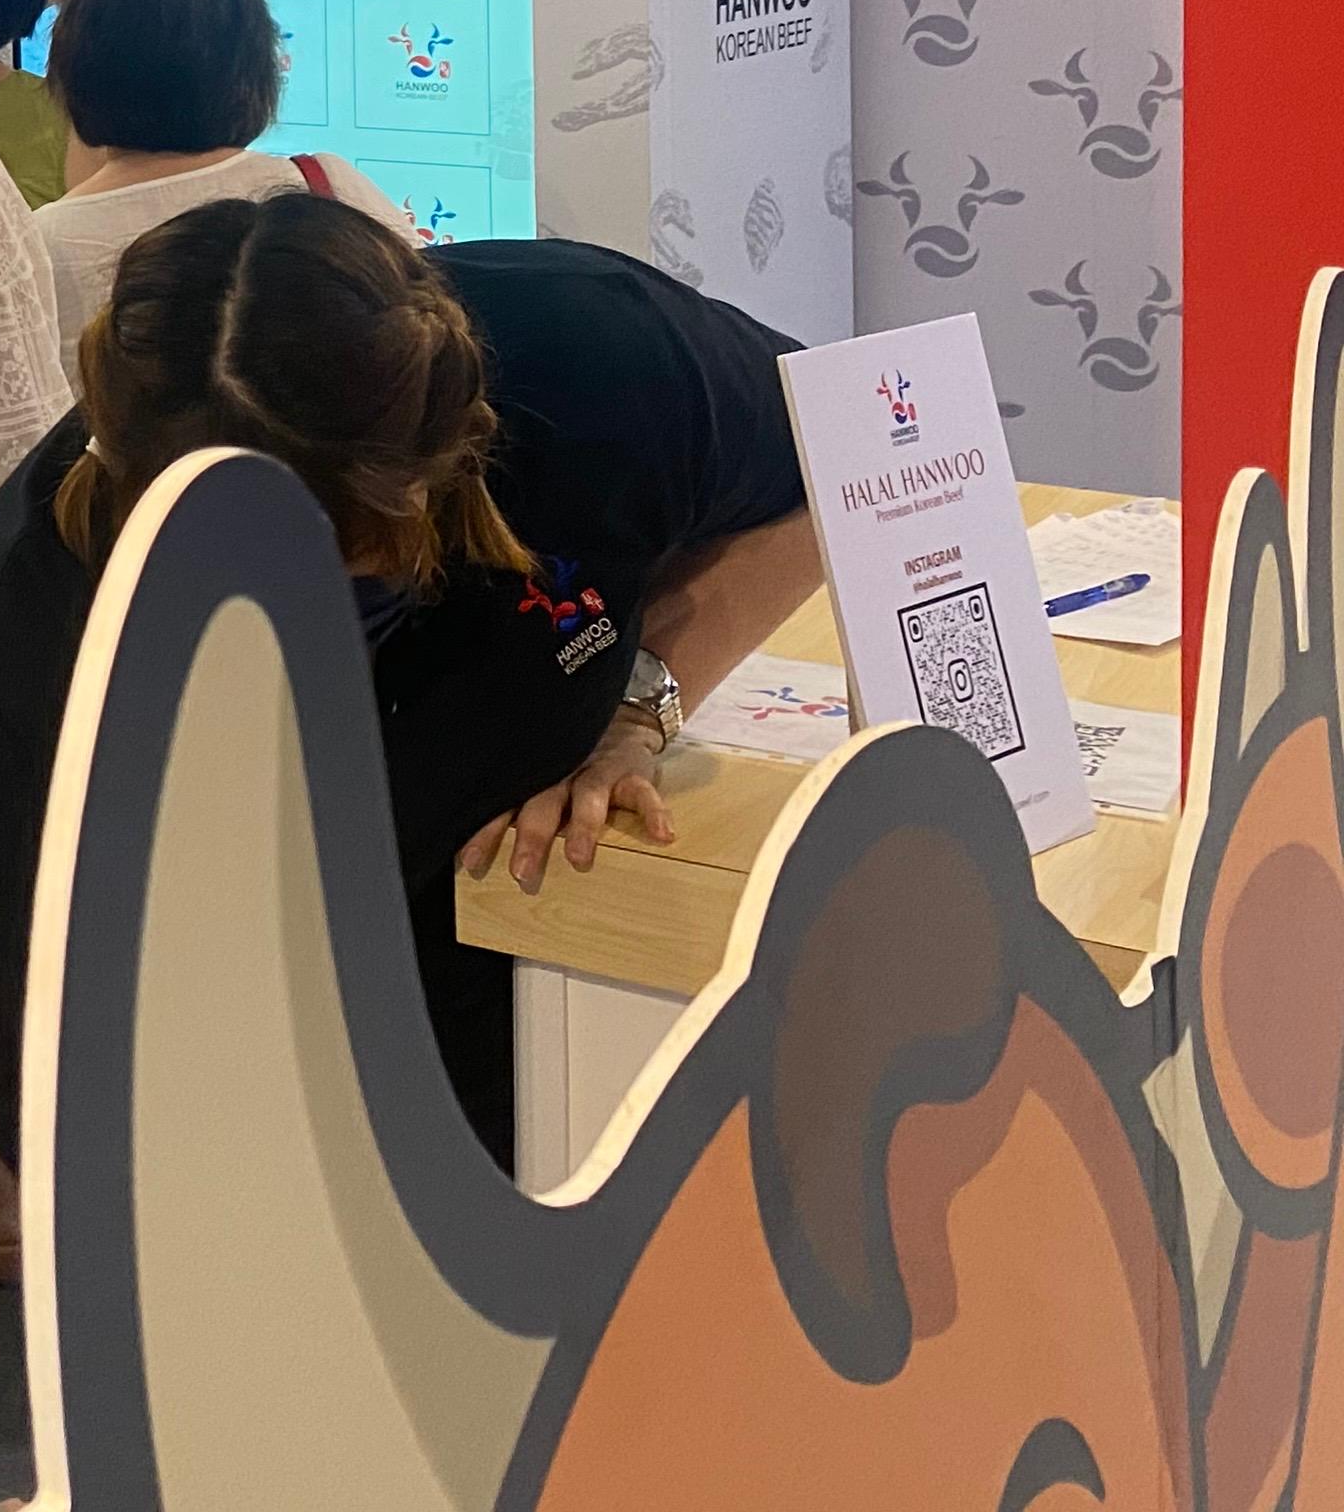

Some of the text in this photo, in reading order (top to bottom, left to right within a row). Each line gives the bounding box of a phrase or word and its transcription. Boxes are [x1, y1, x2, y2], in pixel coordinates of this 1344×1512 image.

[716, 17, 813, 64] KOREAN BEEF
[395, 80, 449, 94] HANWOO
[841, 448, 985, 512] HALAL HANWOO
[903, 545, 963, 577] INSTAGRAM
[555, 617, 612, 667] HANWOO
